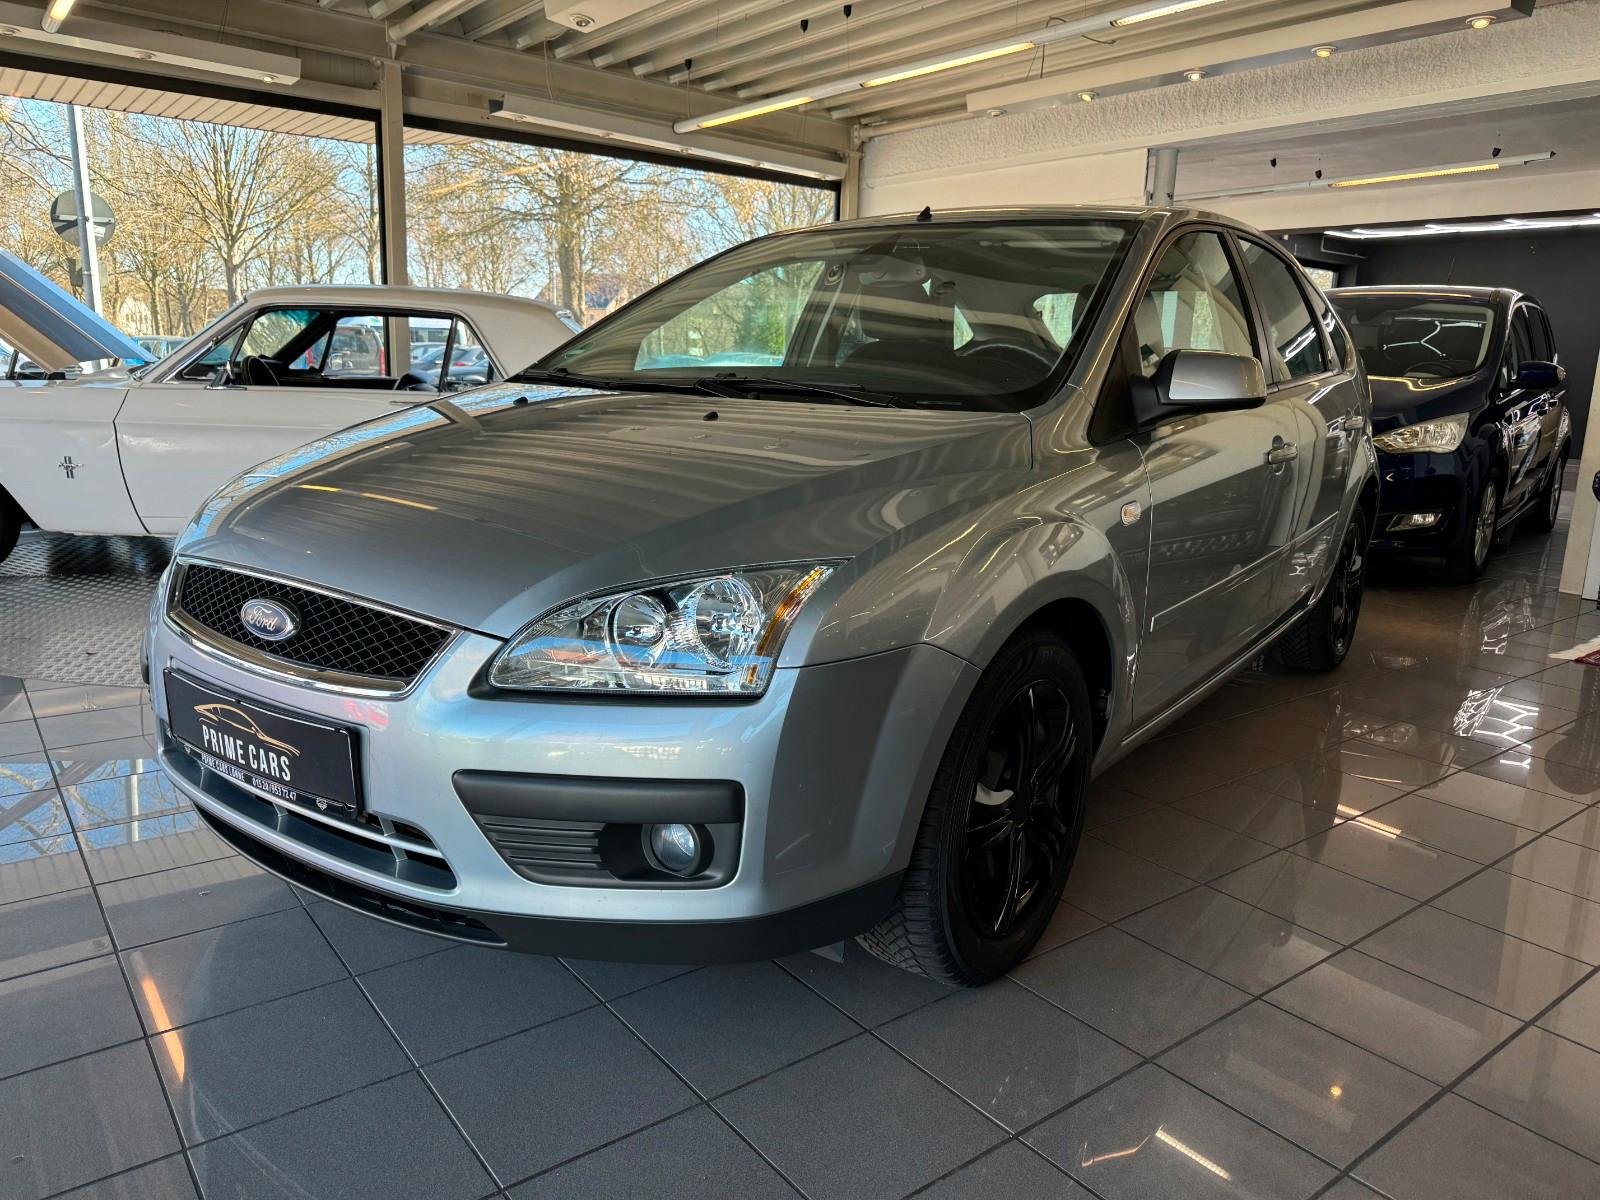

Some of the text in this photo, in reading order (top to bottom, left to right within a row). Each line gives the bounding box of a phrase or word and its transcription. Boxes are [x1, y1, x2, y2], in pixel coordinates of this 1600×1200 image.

[247, 605, 278, 631] Ford
[202, 725, 291, 781] PRIME CARS
